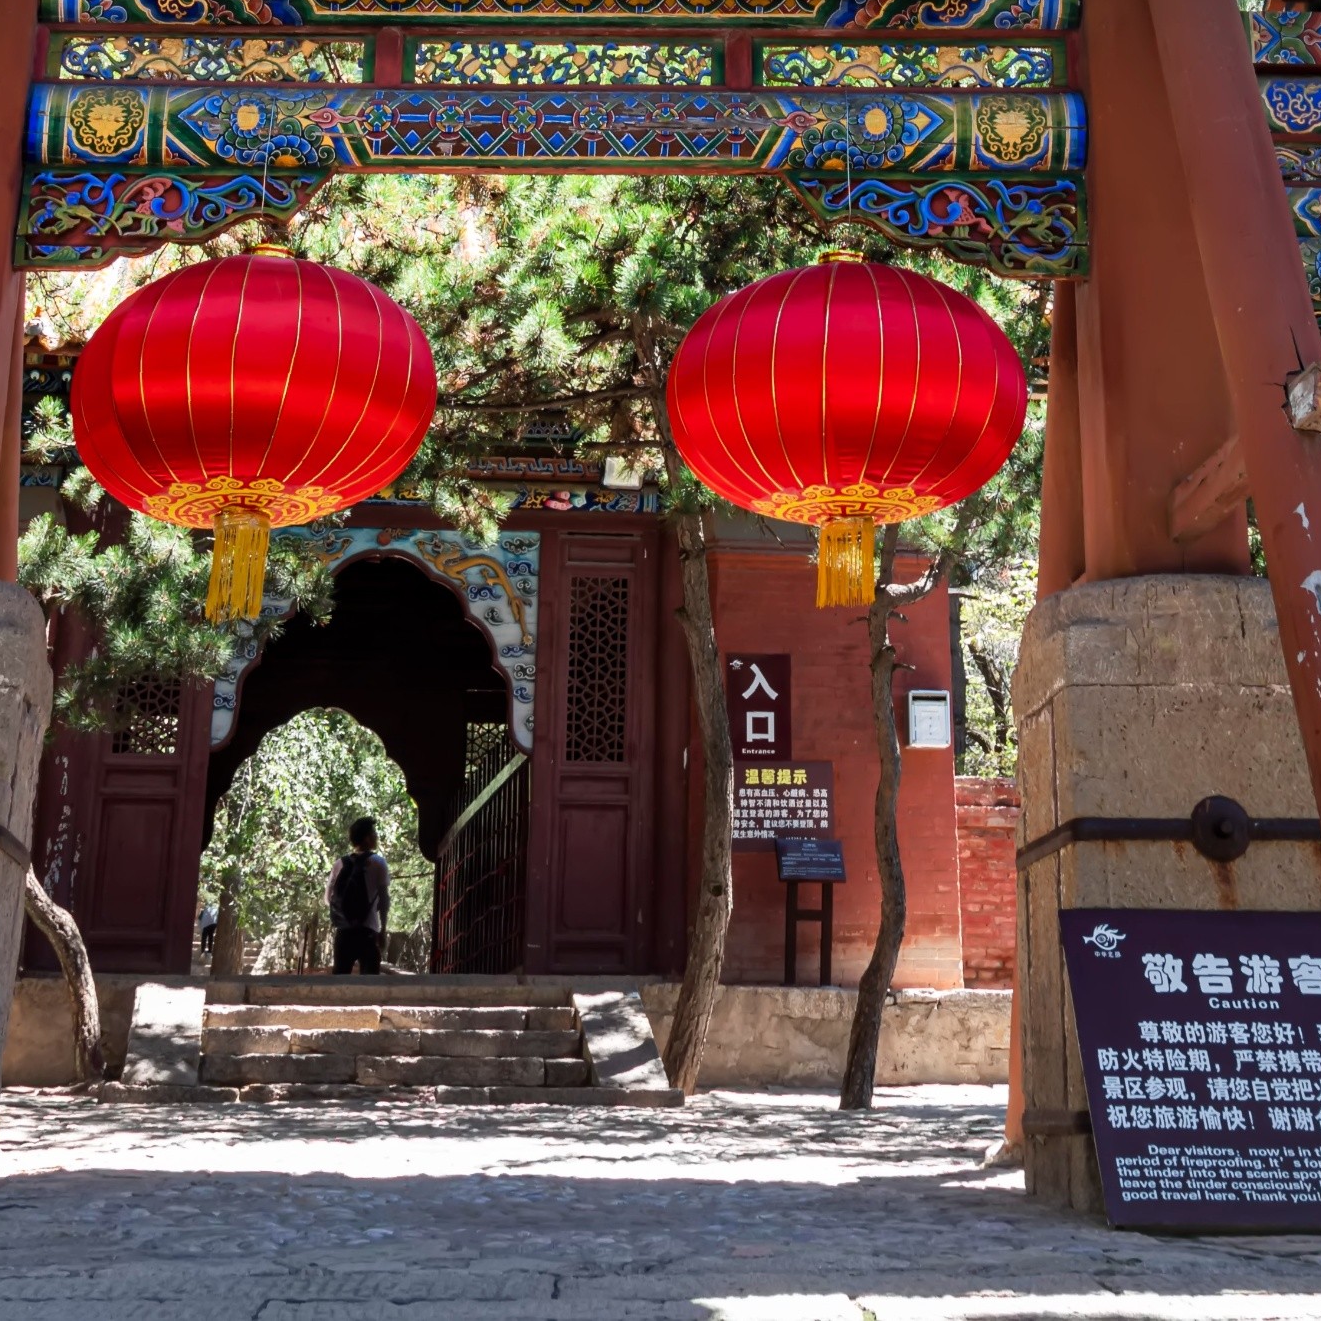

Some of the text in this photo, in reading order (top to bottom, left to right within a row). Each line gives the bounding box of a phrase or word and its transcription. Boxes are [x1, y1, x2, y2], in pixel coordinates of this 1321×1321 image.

[741, 663, 779, 743] 入口
[741, 747, 776, 755] Entrance
[745, 769, 807, 785] 温馨提示
[1208, 996, 1280, 1010] Caution
[1147, 1144, 1181, 1155] Dear
[1248, 1148, 1280, 1157] now
[1283, 1146, 1296, 1157] is
[1298, 1146, 1312, 1157] in
[1115, 1156, 1160, 1167] period
[1163, 1156, 1179, 1167] of
[1181, 1156, 1266, 1170] fireproofing.
[1117, 1166, 1141, 1177] the
[1143, 1167, 1185, 1178] tinder
[1188, 1167, 1216, 1178] into
[1219, 1168, 1243, 1179] the
[1245, 1168, 1289, 1179] scenic
[1119, 1177, 1157, 1188] leave
[1159, 1178, 1183, 1189] the
[1185, 1178, 1228, 1190] tinder
[1231, 1179, 1317, 1193] consciously.
[1121, 1189, 1321, 1204] good travel here. Thank you!
